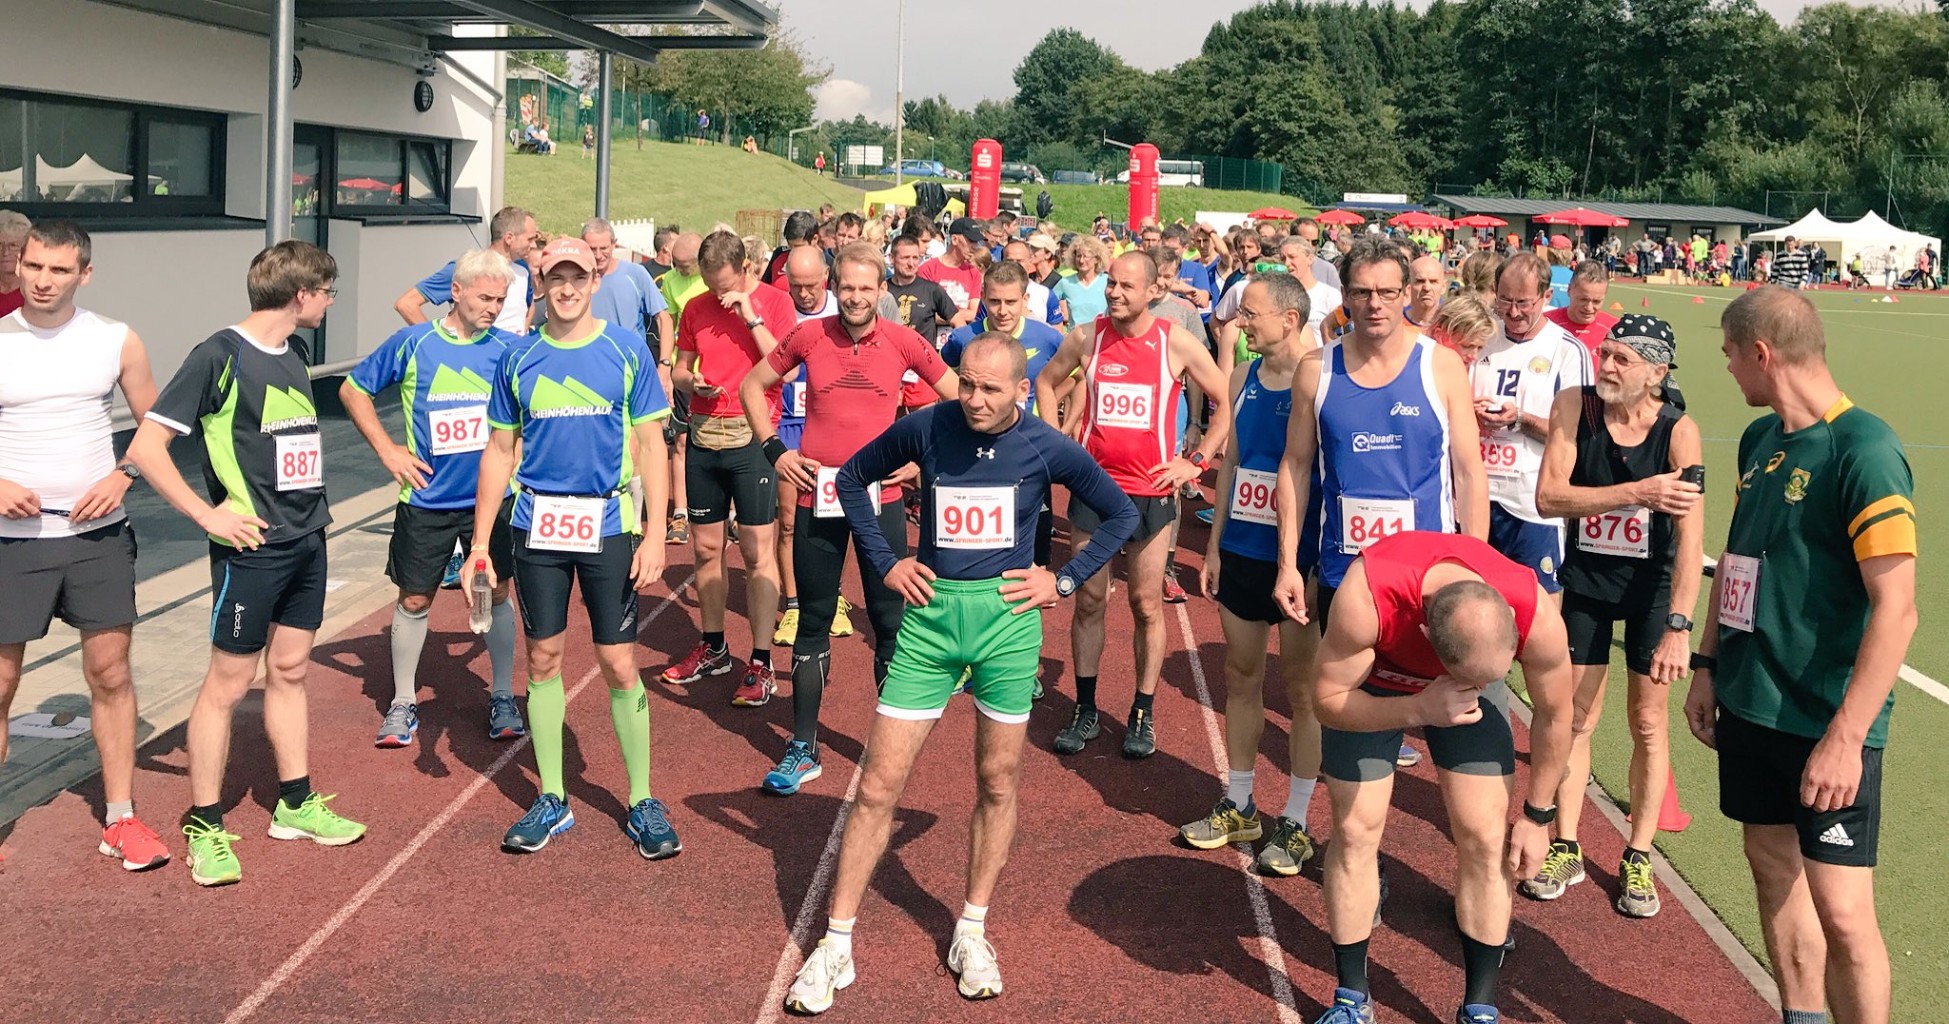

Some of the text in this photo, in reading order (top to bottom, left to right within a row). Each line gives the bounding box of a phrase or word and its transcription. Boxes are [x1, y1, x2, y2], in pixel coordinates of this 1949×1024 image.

[1496, 368, 1520, 397] 12
[1102, 393, 1146, 417] 996
[436, 417, 482, 443] 987
[283, 450, 318, 477] 887
[538, 512, 594, 541] 856
[943, 505, 1002, 536] 901
[1350, 515, 1403, 543] 841
[1585, 514, 1643, 543] 876
[1723, 576, 1751, 614] 857
[1819, 835, 1854, 846] adidas
